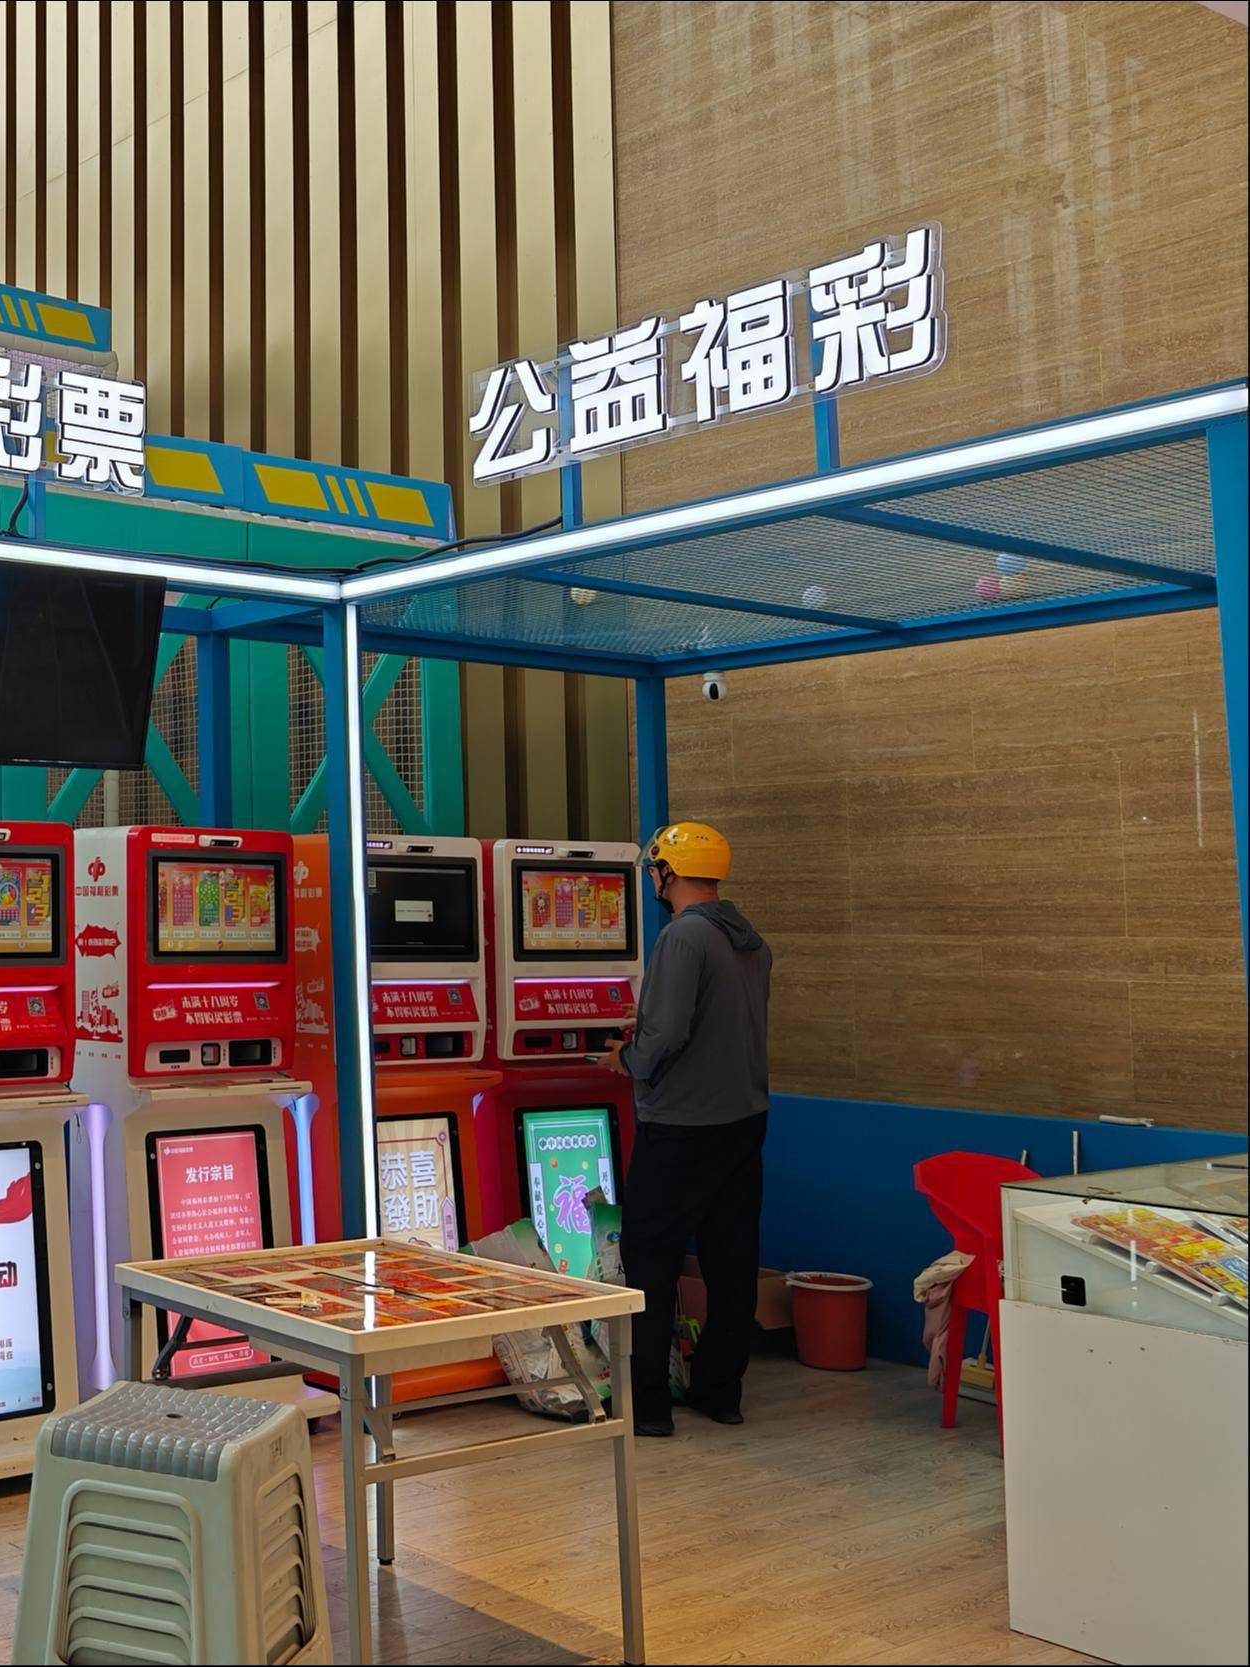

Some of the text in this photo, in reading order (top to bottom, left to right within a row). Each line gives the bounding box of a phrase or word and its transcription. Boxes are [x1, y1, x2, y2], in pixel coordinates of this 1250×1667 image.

[468, 228, 938, 482] 公益福彩
[185, 1164, 235, 1184] 发行宗旨
[381, 1150, 437, 1191] 恭喜
[384, 1192, 440, 1233] 發財
